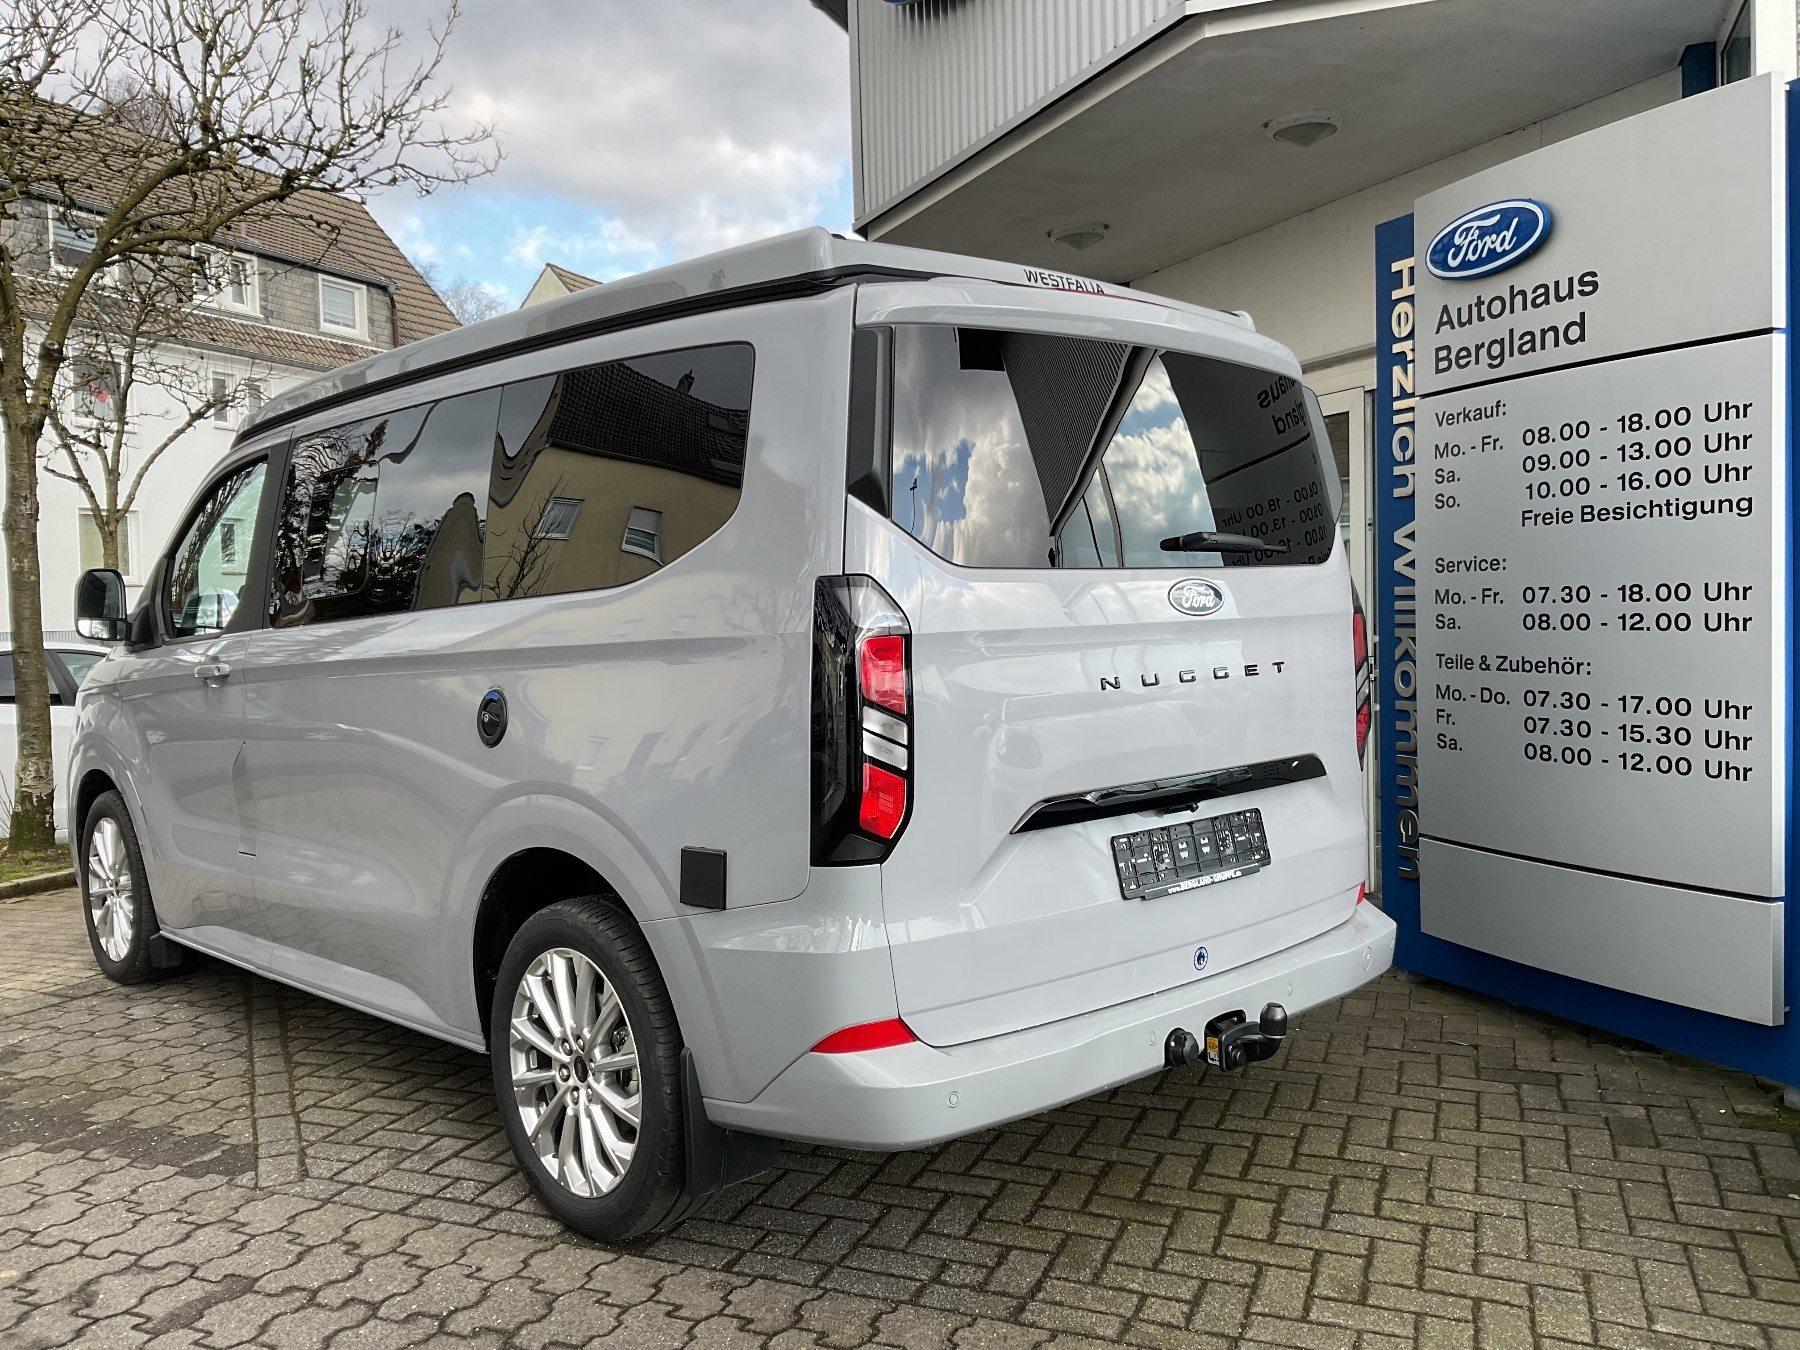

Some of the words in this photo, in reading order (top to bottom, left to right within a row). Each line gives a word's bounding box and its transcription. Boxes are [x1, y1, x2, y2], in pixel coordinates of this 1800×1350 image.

[1448, 214, 1519, 268] Ford
[1024, 269, 1104, 294] WESTFALIA
[1434, 270, 1599, 335] Autohaus
[1434, 311, 1586, 374] Bergland
[1391, 256, 1416, 497] Herzlich
[1435, 400, 1506, 427] Verkauf:
[1435, 442, 1465, 459] Mo.
[1482, 435, 1503, 452] Fr.
[1523, 421, 1590, 446] 08.00
[1617, 407, 1691, 433] 18.00
[1705, 401, 1752, 422] Uhr
[1435, 468, 1460, 484] Sa.
[1523, 449, 1590, 473] 09.00
[1617, 437, 1691, 462] 13.00
[1705, 432, 1752, 453] Uhr
[1435, 493, 1460, 509] So.
[1526, 477, 1590, 500] 10.00
[1617, 467, 1691, 491] 16.00
[1705, 463, 1752, 484] Uhr
[1522, 508, 1573, 527] Freie
[1581, 497, 1752, 522] Besichtigung
[1435, 556, 1506, 573] Service:
[1181, 586, 1215, 608] Ford
[1435, 589, 1465, 604] Mo.
[1482, 588, 1503, 604] Fr.
[1523, 585, 1590, 603] 07.30
[1618, 583, 1691, 602] 18.00
[1705, 582, 1752, 601] Uhr
[1436, 614, 1460, 629] Sa.
[1523, 613, 1590, 631] 08.00
[1618, 613, 1691, 631] 12.00
[1705, 613, 1752, 632] Uhr
[1101, 661, 1285, 691] NUGGET
[1436, 654, 1474, 670] Teile
[1479, 655, 1491, 671] &
[1496, 655, 1590, 675] Zubehör:
[1393, 520, 1420, 880] Willkommen
[1436, 684, 1466, 701] Mo.
[1481, 687, 1510, 705] Do.
[1524, 690, 1590, 710] 07.30
[1618, 695, 1691, 716] 17.00
[1705, 699, 1752, 720] Uhr
[1437, 709, 1455, 725] Fr.
[1524, 716, 1591, 738] 07.30
[1618, 724, 1691, 746] 15.30
[1705, 729, 1752, 750] Uhr
[1437, 733, 1462, 751] Sa.
[1524, 743, 1591, 766] 08.00
[1618, 753, 1692, 776] 12.00
[1705, 760, 1752, 781] Uhr
